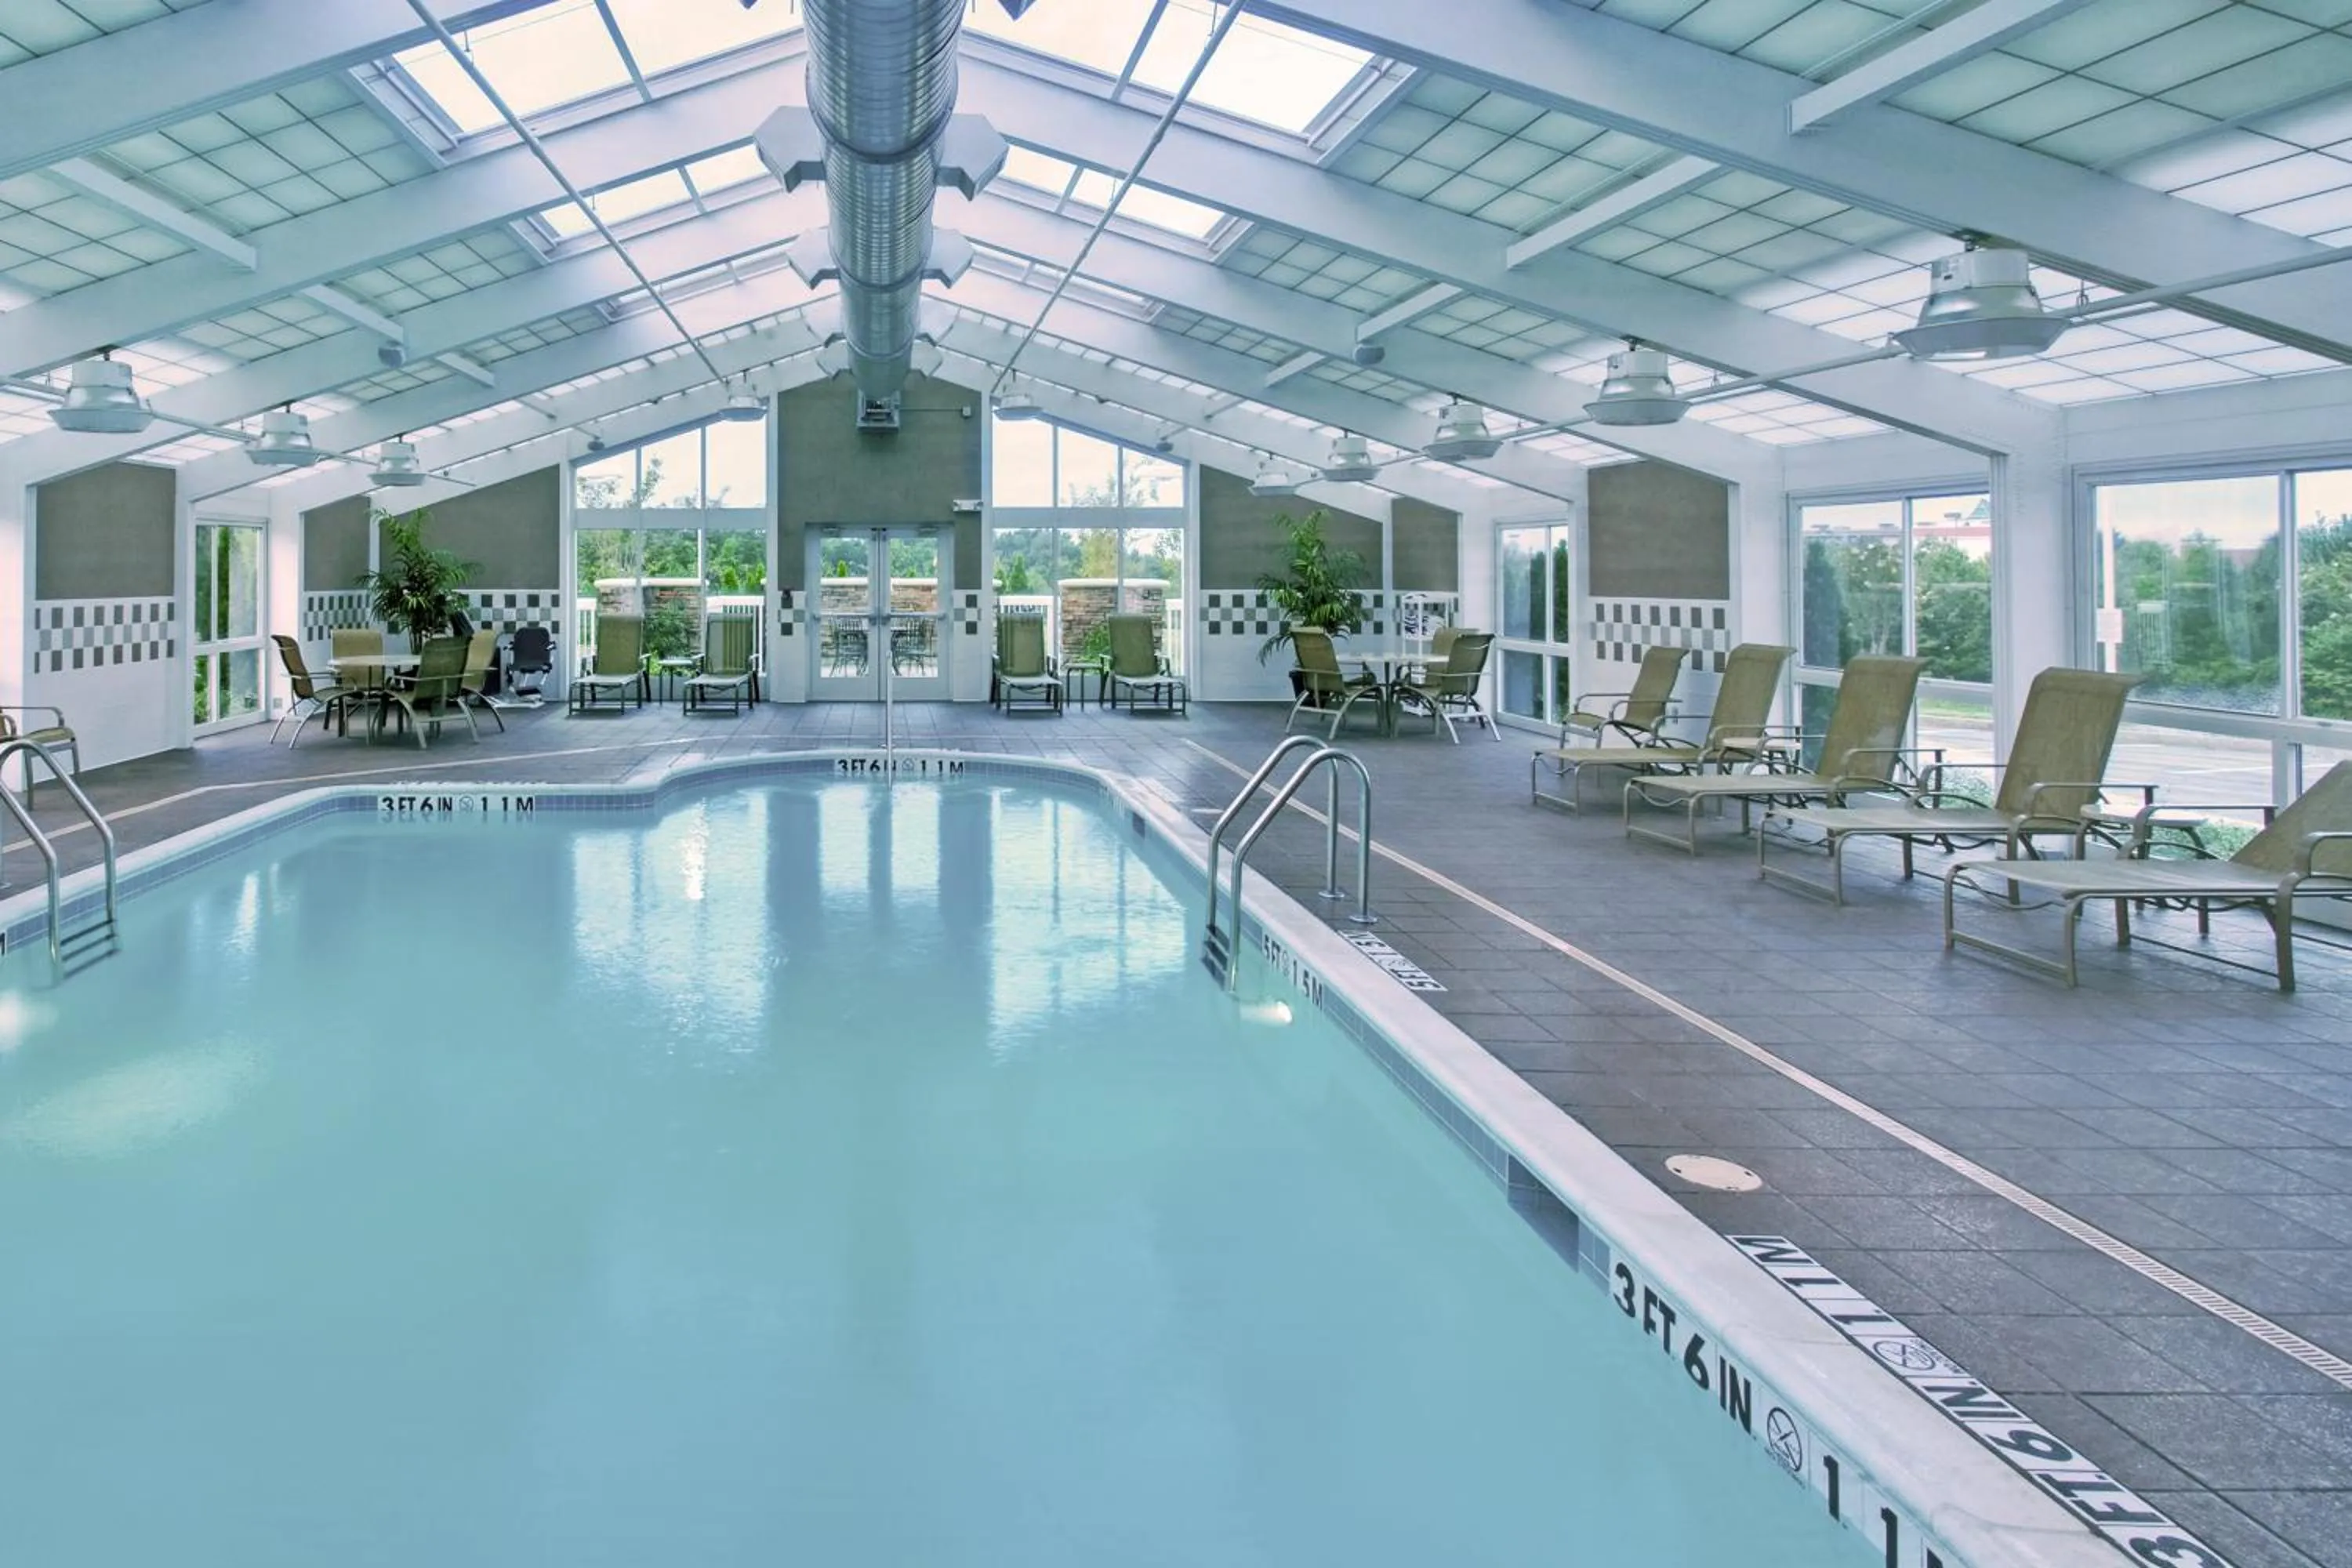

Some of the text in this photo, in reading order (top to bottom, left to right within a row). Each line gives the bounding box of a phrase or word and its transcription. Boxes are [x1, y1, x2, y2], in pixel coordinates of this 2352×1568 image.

[837, 759, 848, 771] 3
[869, 760, 880, 771] 6
[382, 797, 394, 811] 3
[397, 797, 416, 811] FT
[420, 797, 434, 811] 6
[437, 797, 452, 811] IN
[1613, 1262, 1636, 1318] 3
[1683, 1333, 1710, 1391] 6
